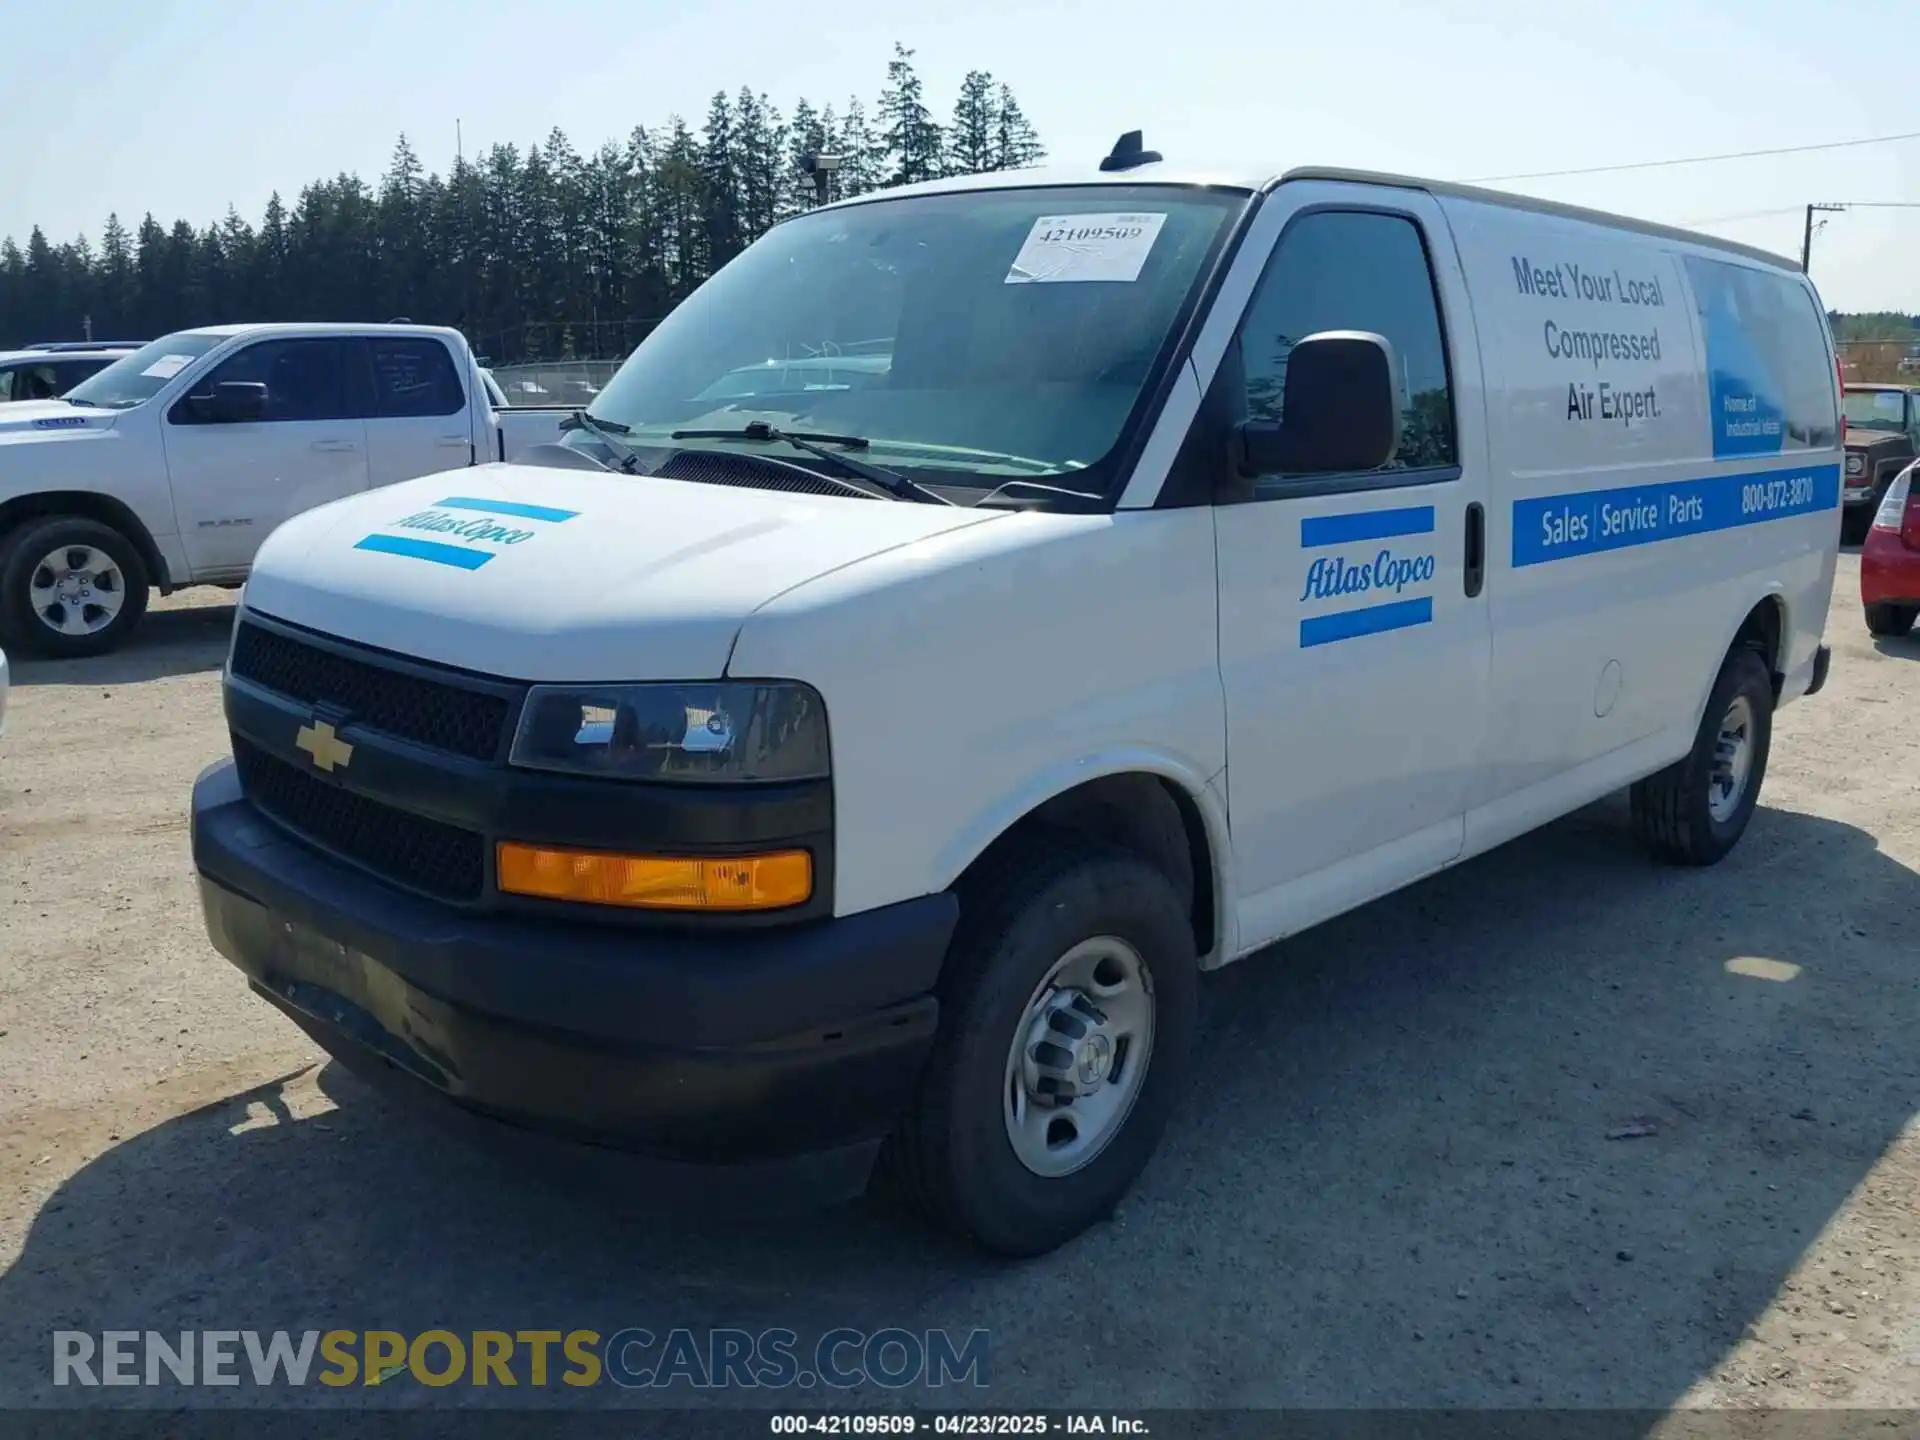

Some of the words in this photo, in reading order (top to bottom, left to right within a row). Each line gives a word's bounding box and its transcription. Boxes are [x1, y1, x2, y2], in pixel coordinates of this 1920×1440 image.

[1040, 227, 1142, 241] 42109509
[1511, 255, 1568, 298] Meet
[1565, 263, 1613, 301] Your
[1613, 269, 1665, 307] Local
[1544, 319, 1662, 371] Compressed
[1567, 382, 1595, 421] Air
[1598, 382, 1662, 428] Expert.
[1541, 506, 1589, 546] Sales
[1601, 498, 1658, 536] Service
[1668, 494, 1703, 525] Parts
[1741, 476, 1814, 514] 800-872-3870
